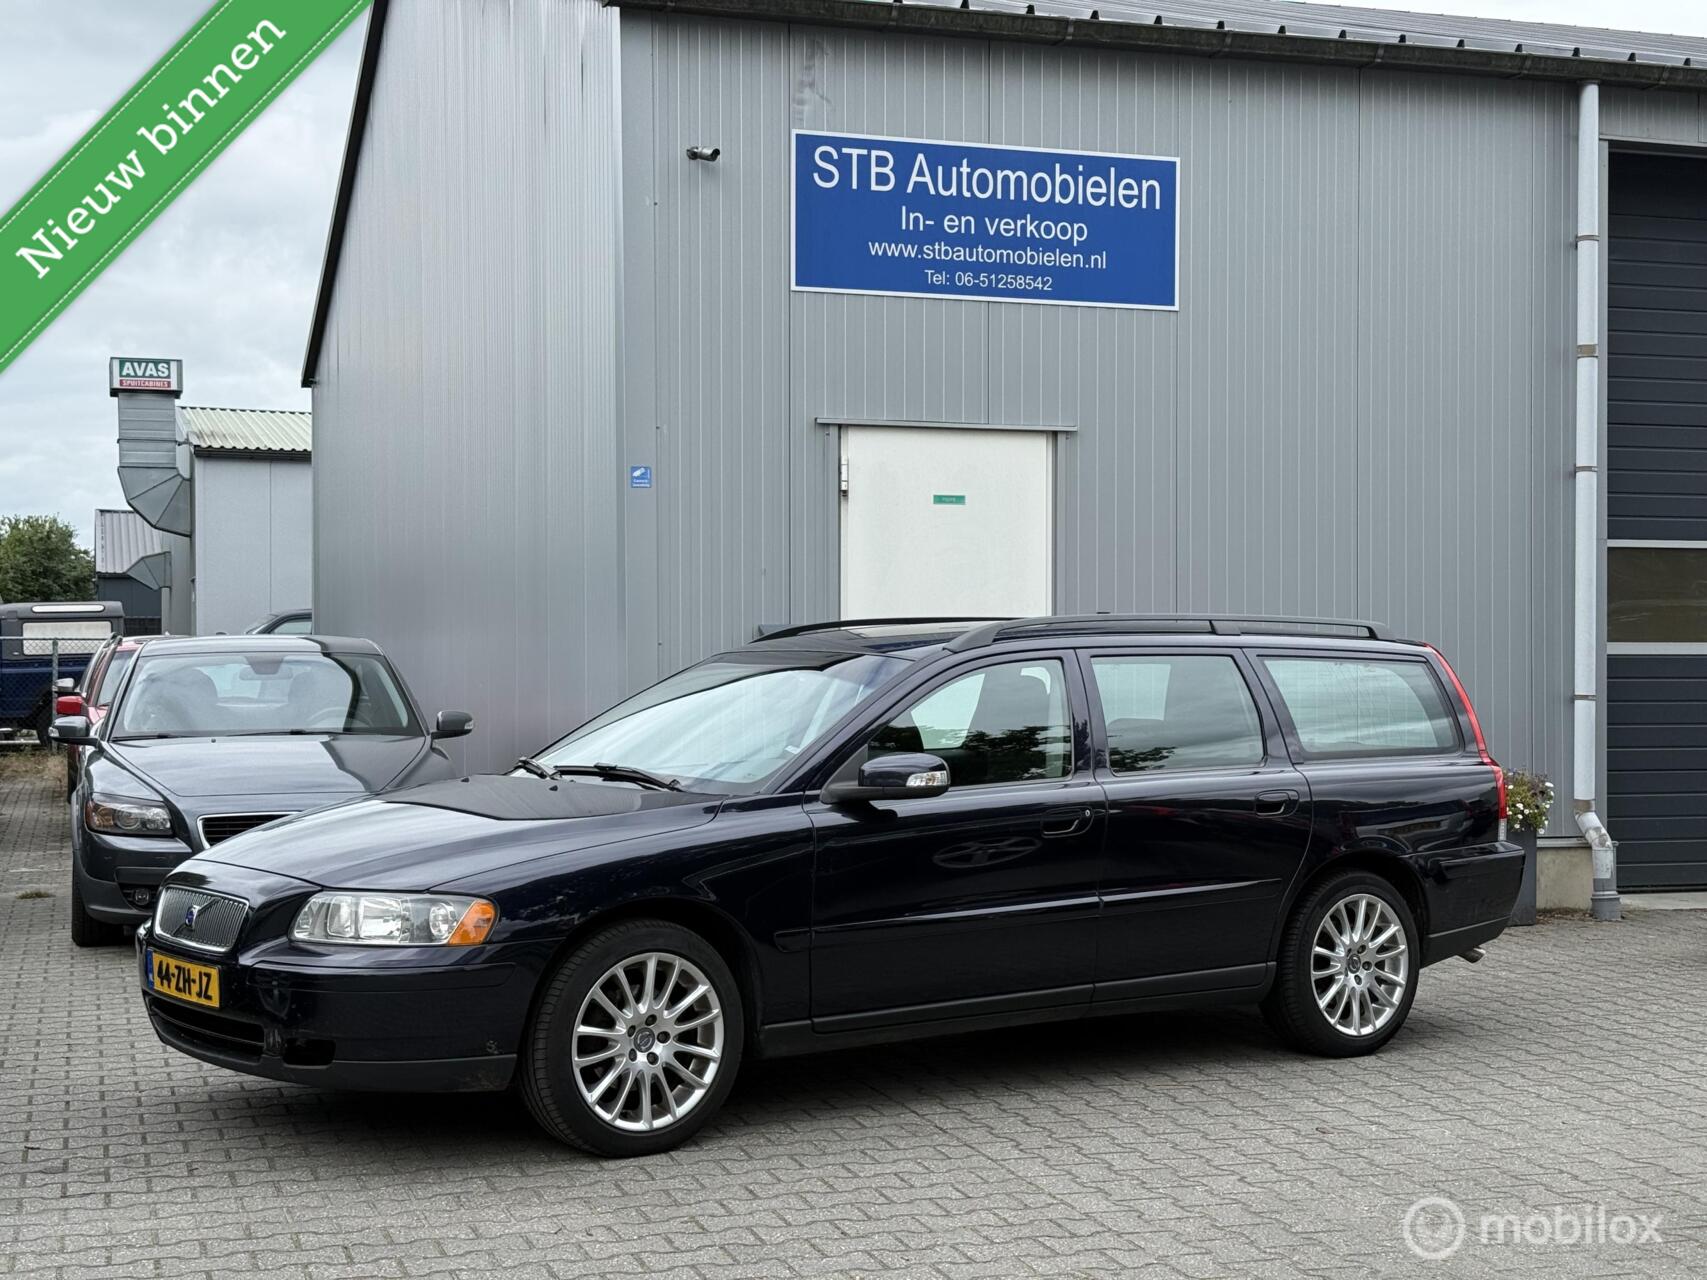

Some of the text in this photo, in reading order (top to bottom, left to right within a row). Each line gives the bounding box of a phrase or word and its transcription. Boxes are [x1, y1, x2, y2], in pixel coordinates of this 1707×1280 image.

[812, 145, 1162, 210] STB Automobielen
[900, 205, 1088, 246] In- en verkoop
[868, 240, 1107, 269] www.stbautomobielen.nl
[924, 269, 1053, 291] Tel: 06-51258542
[121, 361, 170, 377] AVAS
[122, 380, 169, 388] SPUITCABINES
[156, 960, 213, 1001] 44-ZH-JZ
